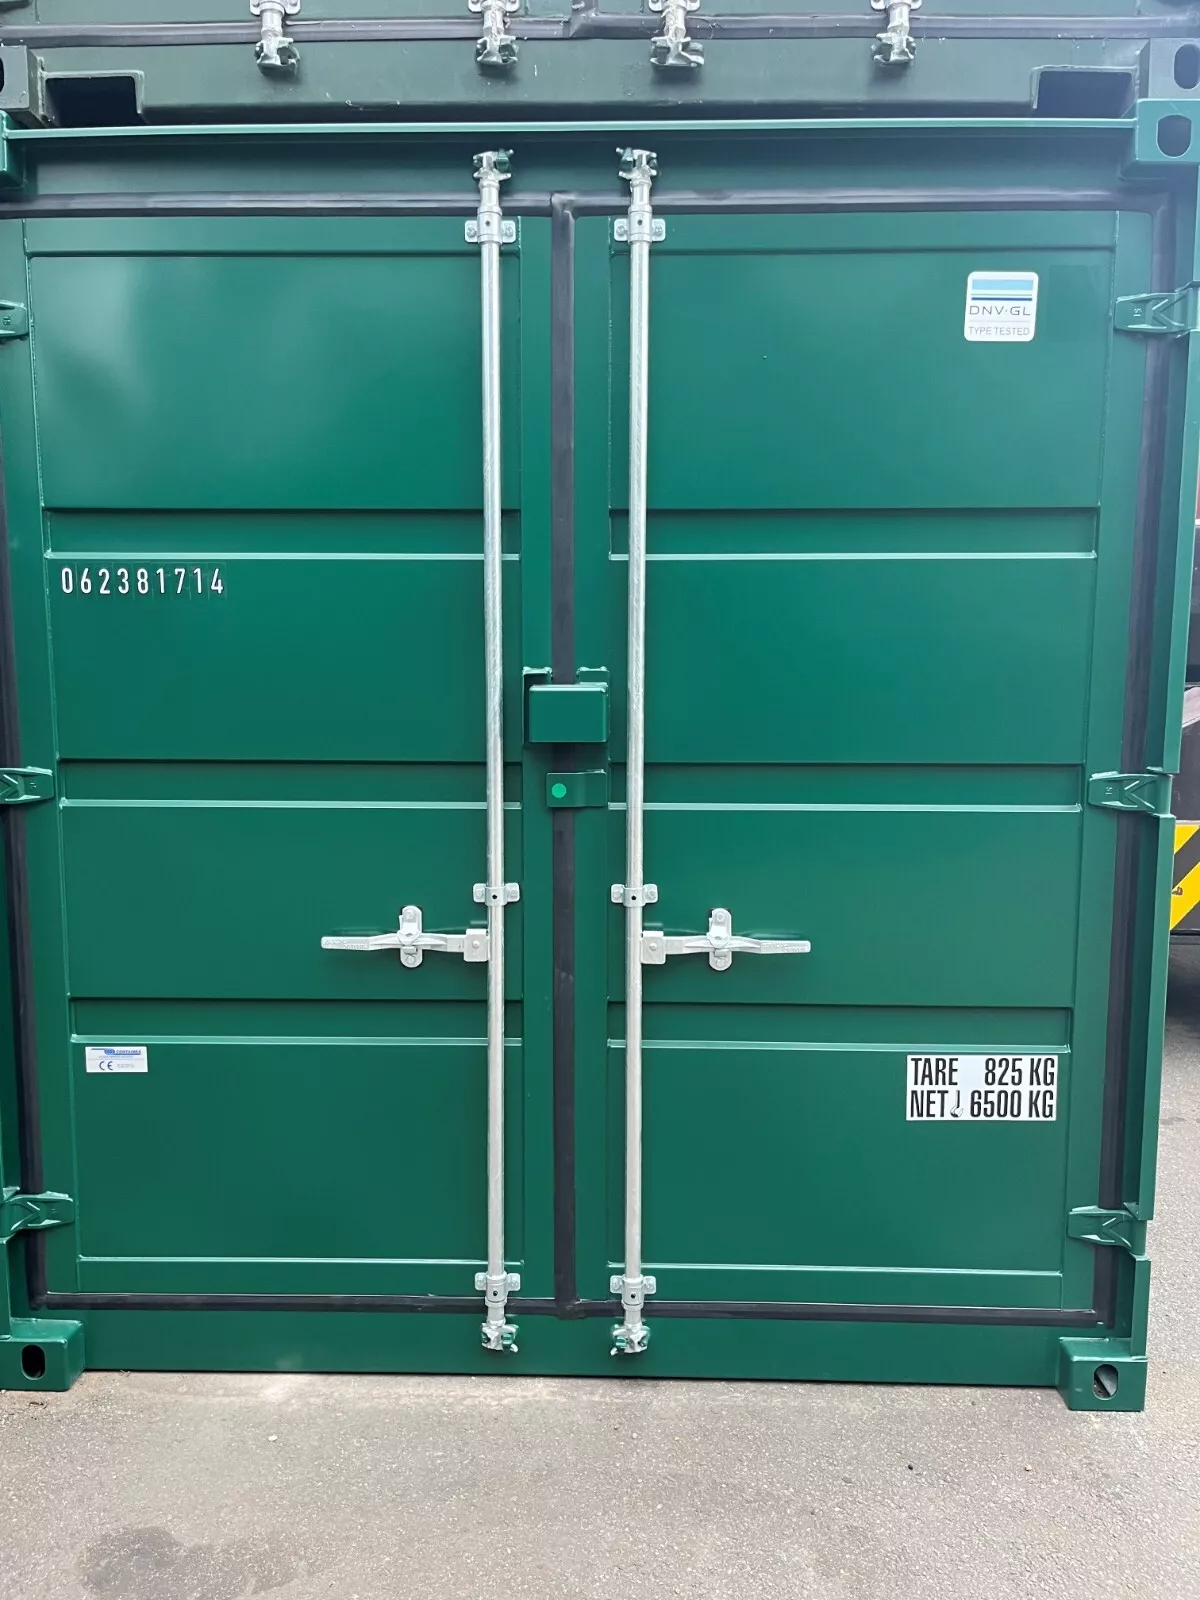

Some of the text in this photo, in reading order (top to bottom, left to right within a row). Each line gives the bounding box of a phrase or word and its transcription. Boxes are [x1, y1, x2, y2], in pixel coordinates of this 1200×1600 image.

[968, 326, 1030, 336] TYPE TESTED
[61, 567, 223, 594] 062381714
[911, 1057, 1055, 1086] TARE 825 KG
[910, 1090, 1054, 1118] NET 6500 KG
